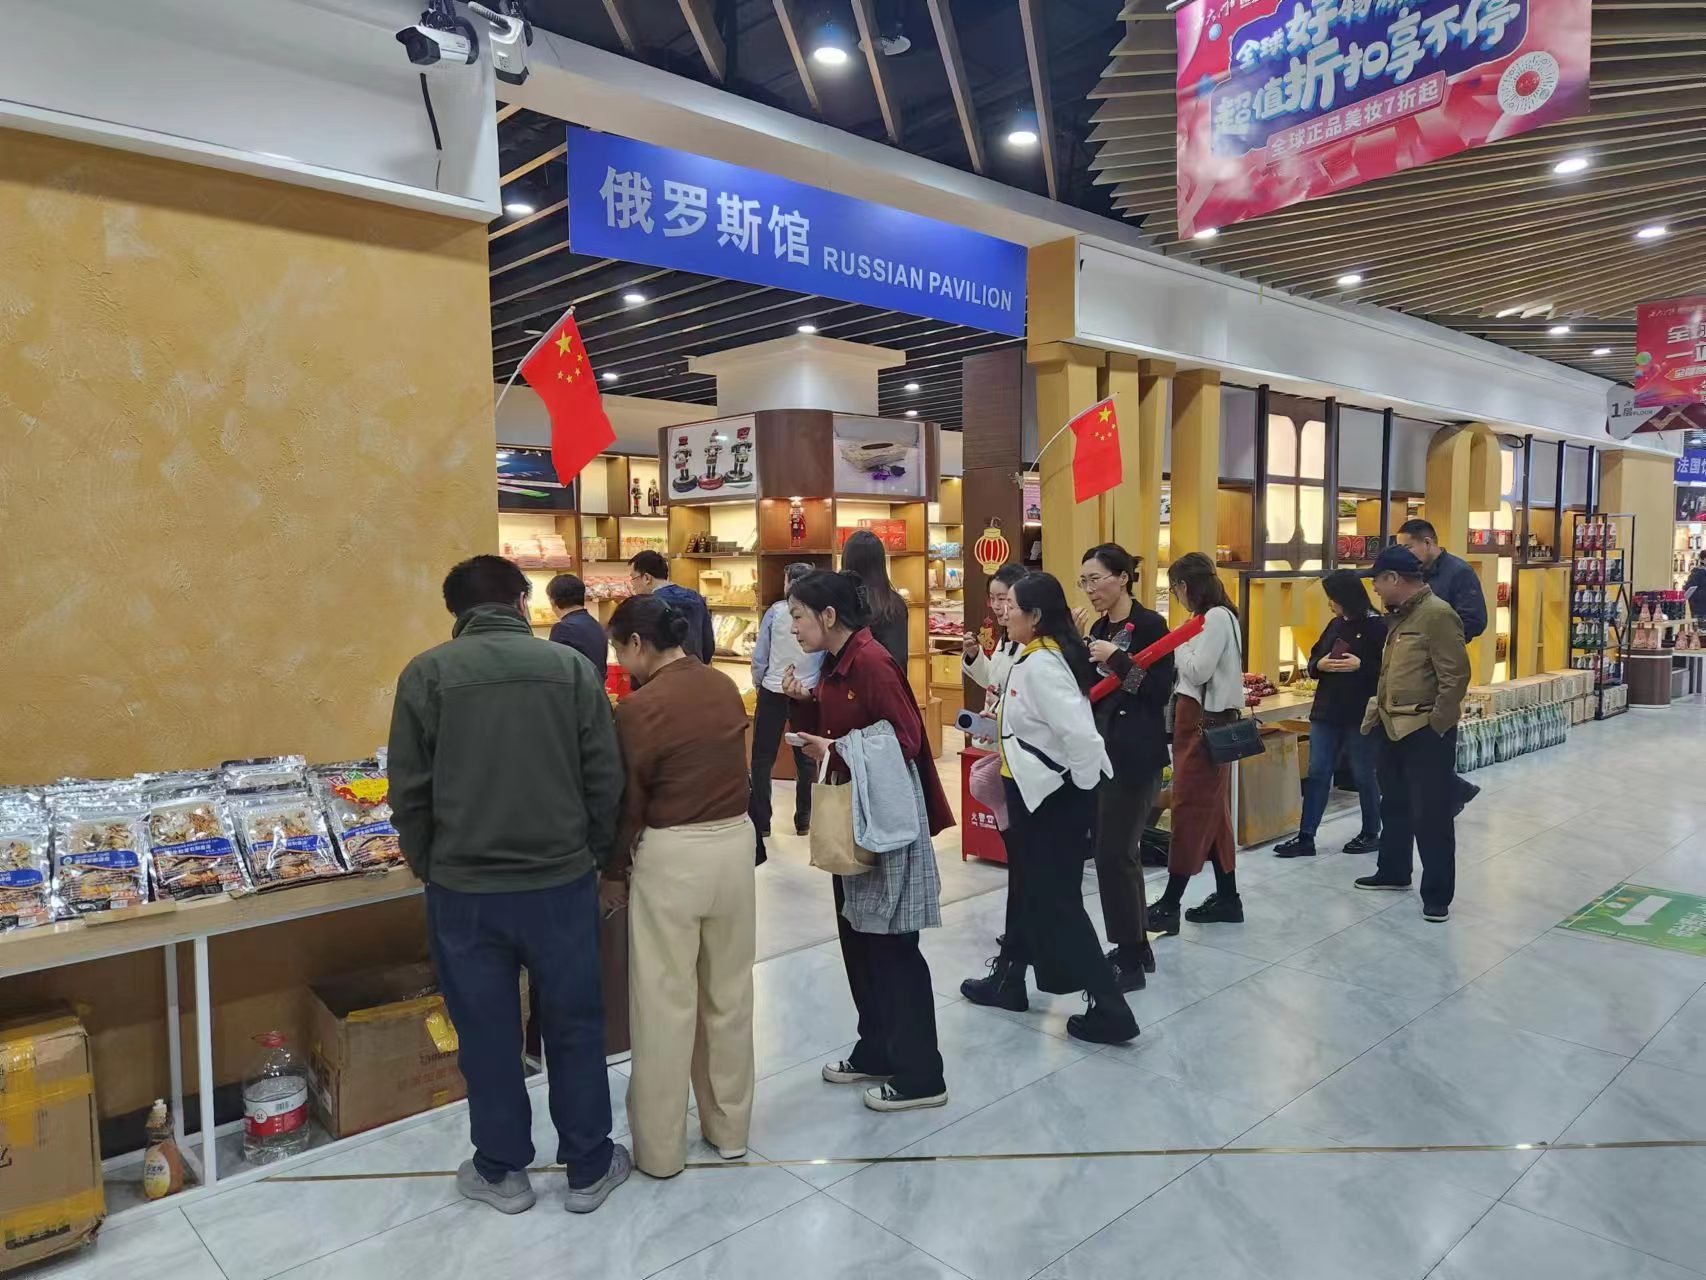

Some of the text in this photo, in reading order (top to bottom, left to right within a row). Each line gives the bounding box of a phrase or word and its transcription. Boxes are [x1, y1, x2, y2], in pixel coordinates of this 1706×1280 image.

[1215, 0, 1521, 135] 超值折扣享不停
[1271, 80, 1439, 157] 全球正品美妆7折起
[599, 165, 1012, 312] 俄罗斯馆 RUSSIAN PAVILION
